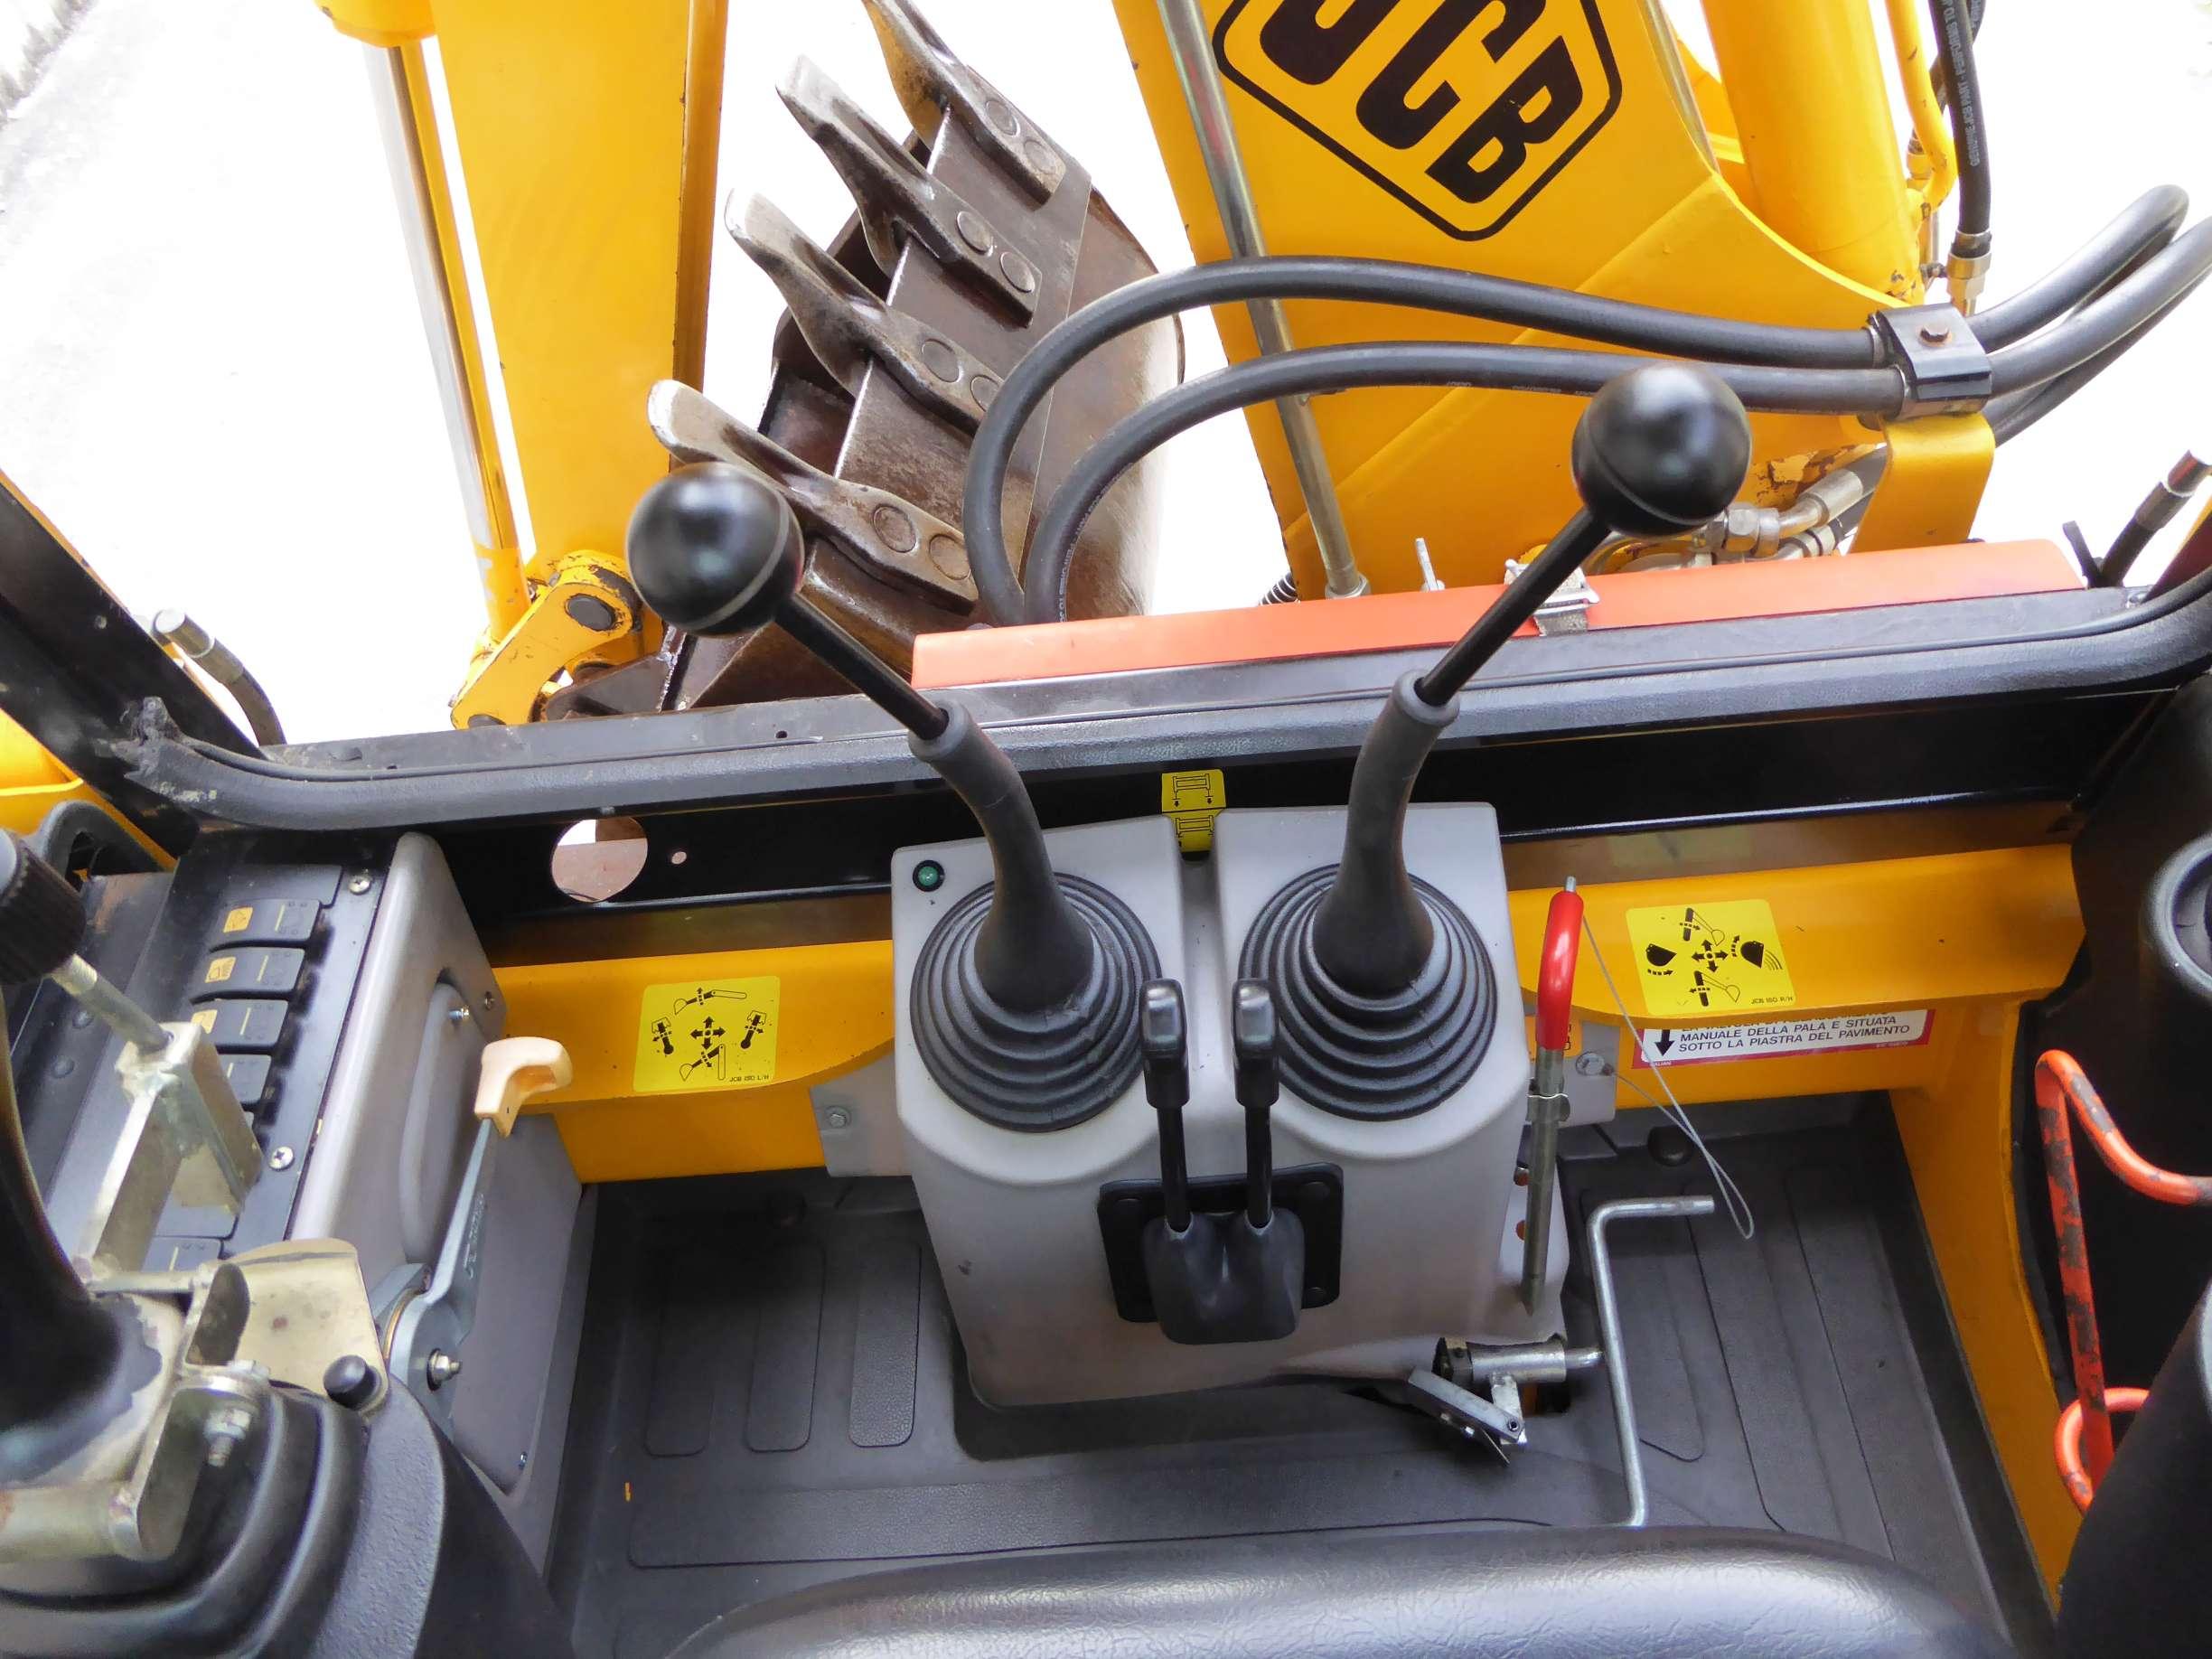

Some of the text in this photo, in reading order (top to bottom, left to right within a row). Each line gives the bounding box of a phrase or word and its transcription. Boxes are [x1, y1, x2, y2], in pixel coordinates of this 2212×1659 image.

[1679, 1025, 1909, 1053] SOTTO LA PIASTRA DEL PAVIMENTO
[1680, 1029, 1743, 1042] MANUALE
[1748, 1026, 1788, 1036] DELLA
[1794, 1021, 1825, 1032] PALA
[1832, 1020, 1840, 1029] E
[1846, 1016, 1896, 1028] SITUATA
